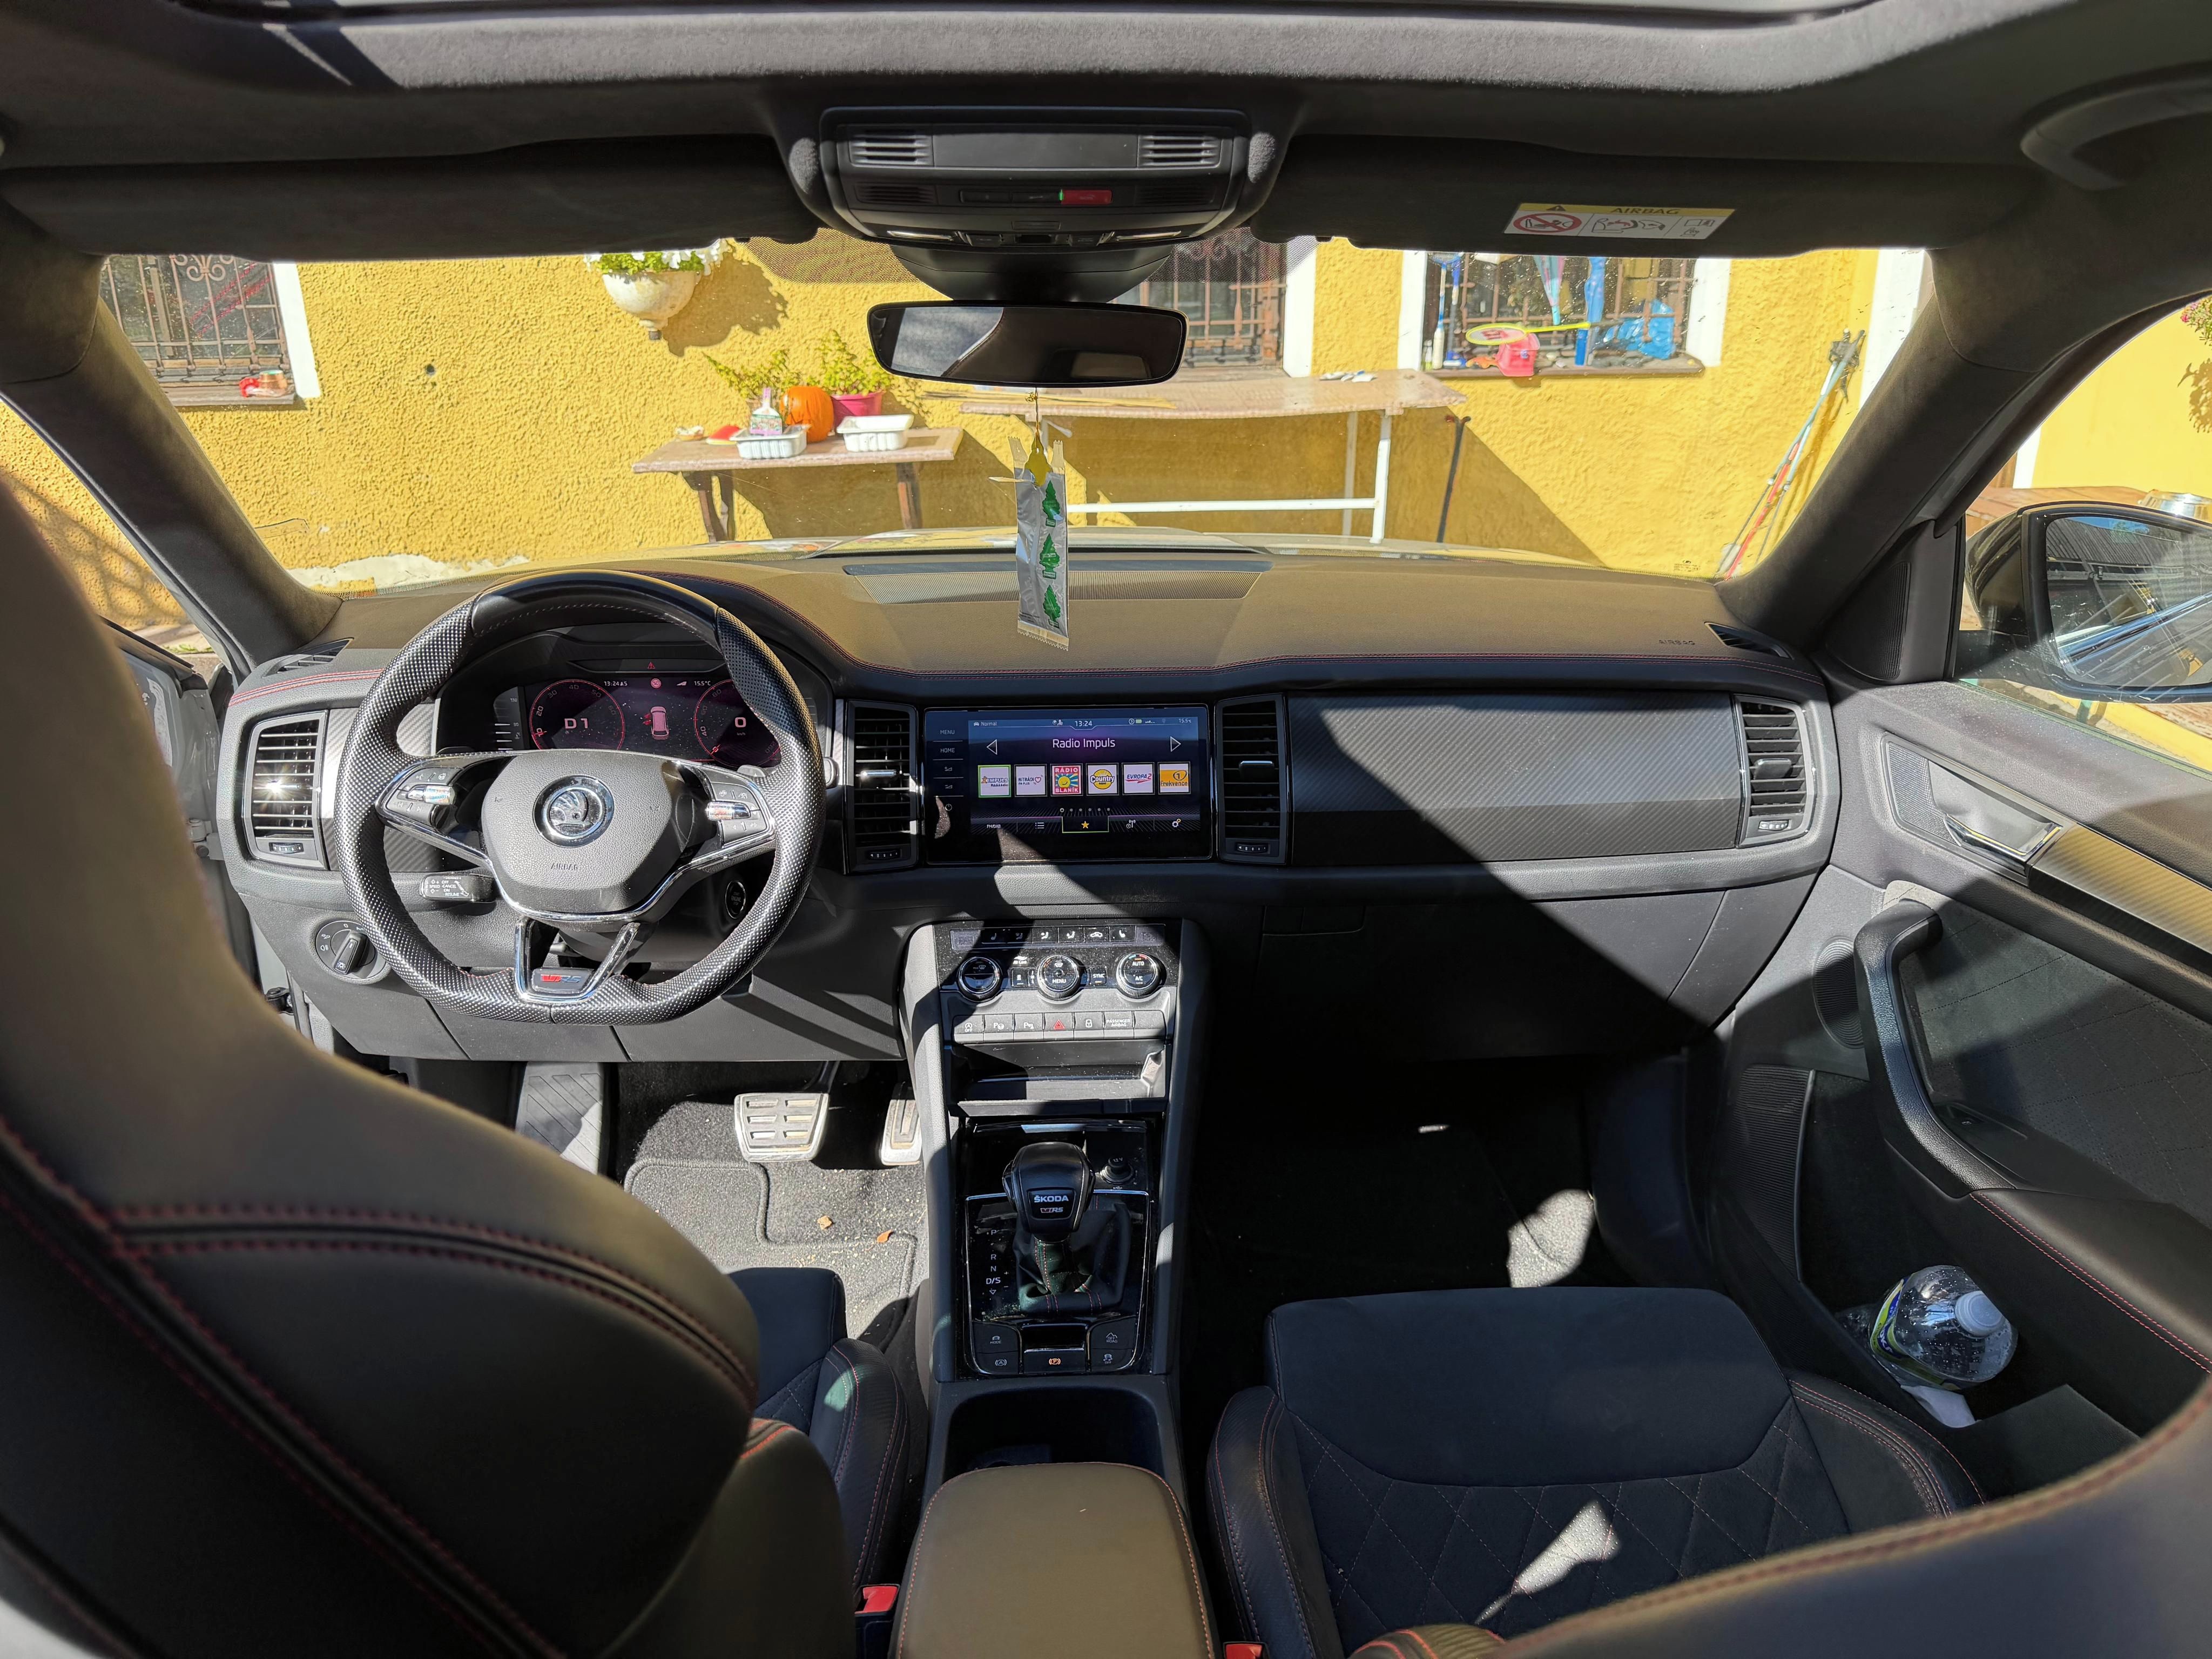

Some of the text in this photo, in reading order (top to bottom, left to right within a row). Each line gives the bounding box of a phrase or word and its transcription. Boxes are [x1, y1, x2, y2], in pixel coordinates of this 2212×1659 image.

[548, 690, 557, 698] 30
[536, 706, 544, 716] 20
[1053, 738, 1116, 750] Radio Impuls
[1090, 774, 1115, 784] Country
